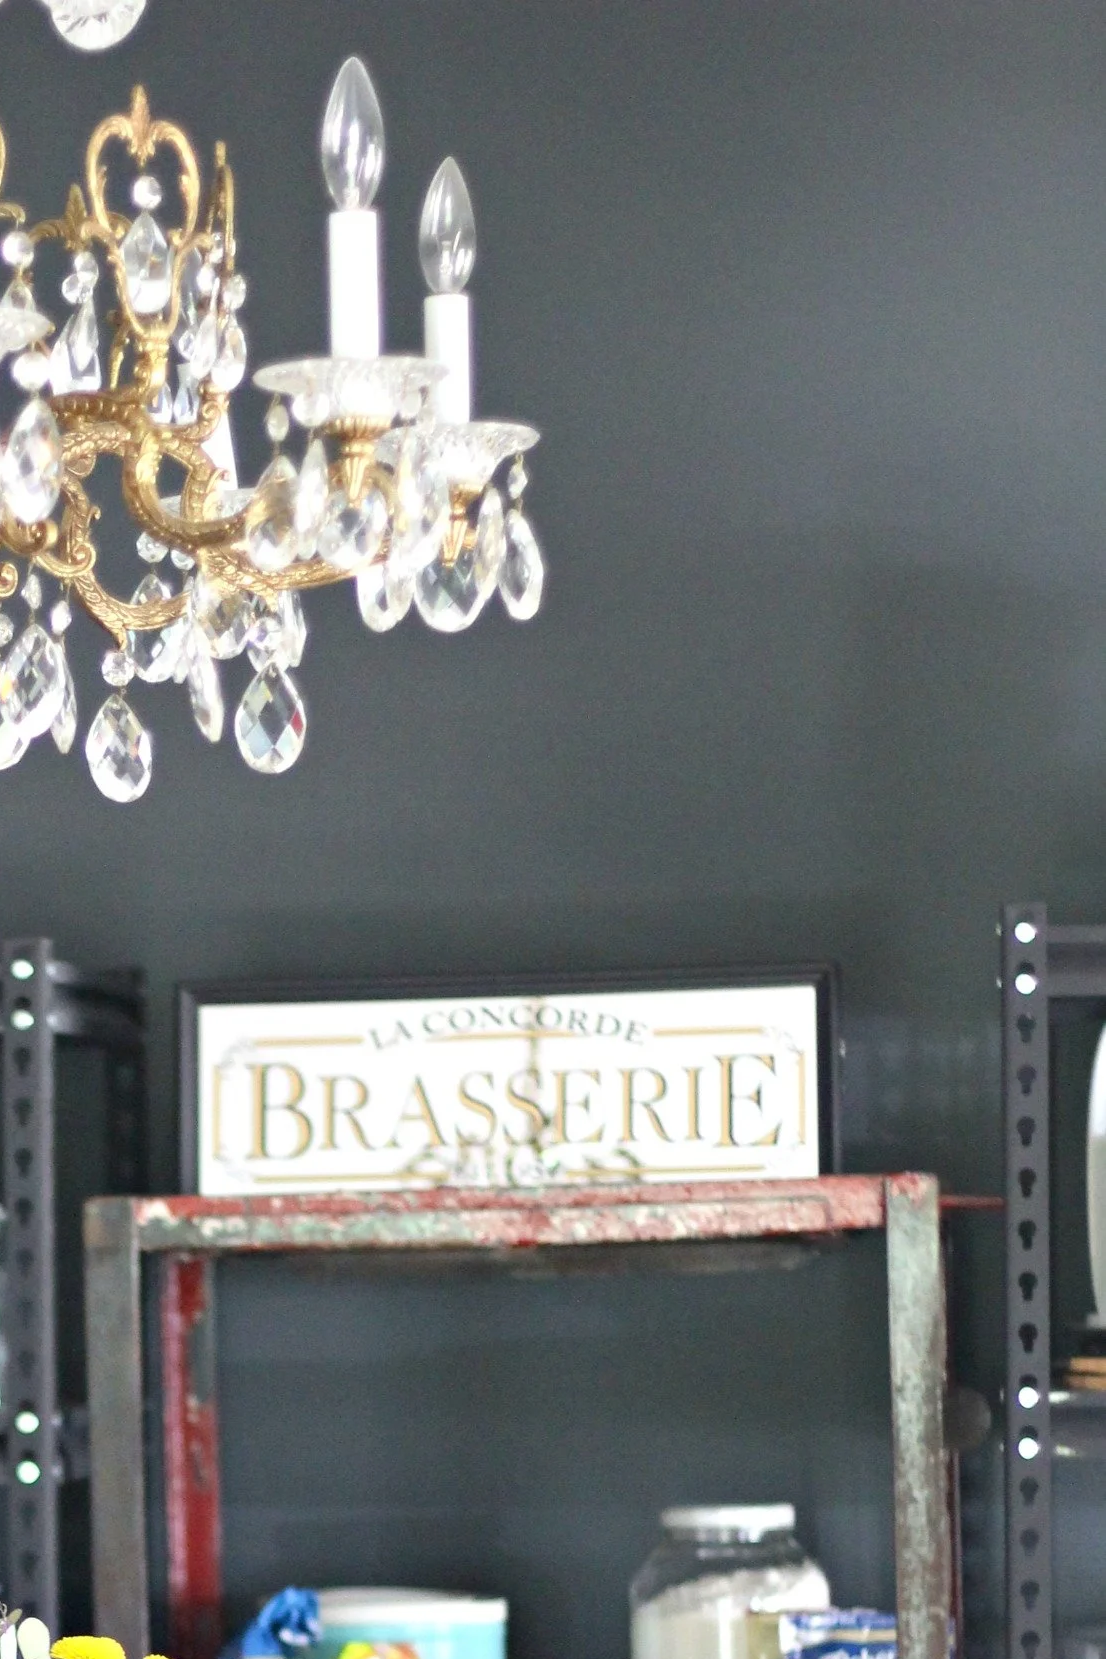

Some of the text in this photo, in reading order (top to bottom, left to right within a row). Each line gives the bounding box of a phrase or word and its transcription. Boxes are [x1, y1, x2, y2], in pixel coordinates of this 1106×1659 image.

[369, 1004, 647, 1051] LA CONCORDE
[244, 1053, 782, 1161] BRASSERIE
